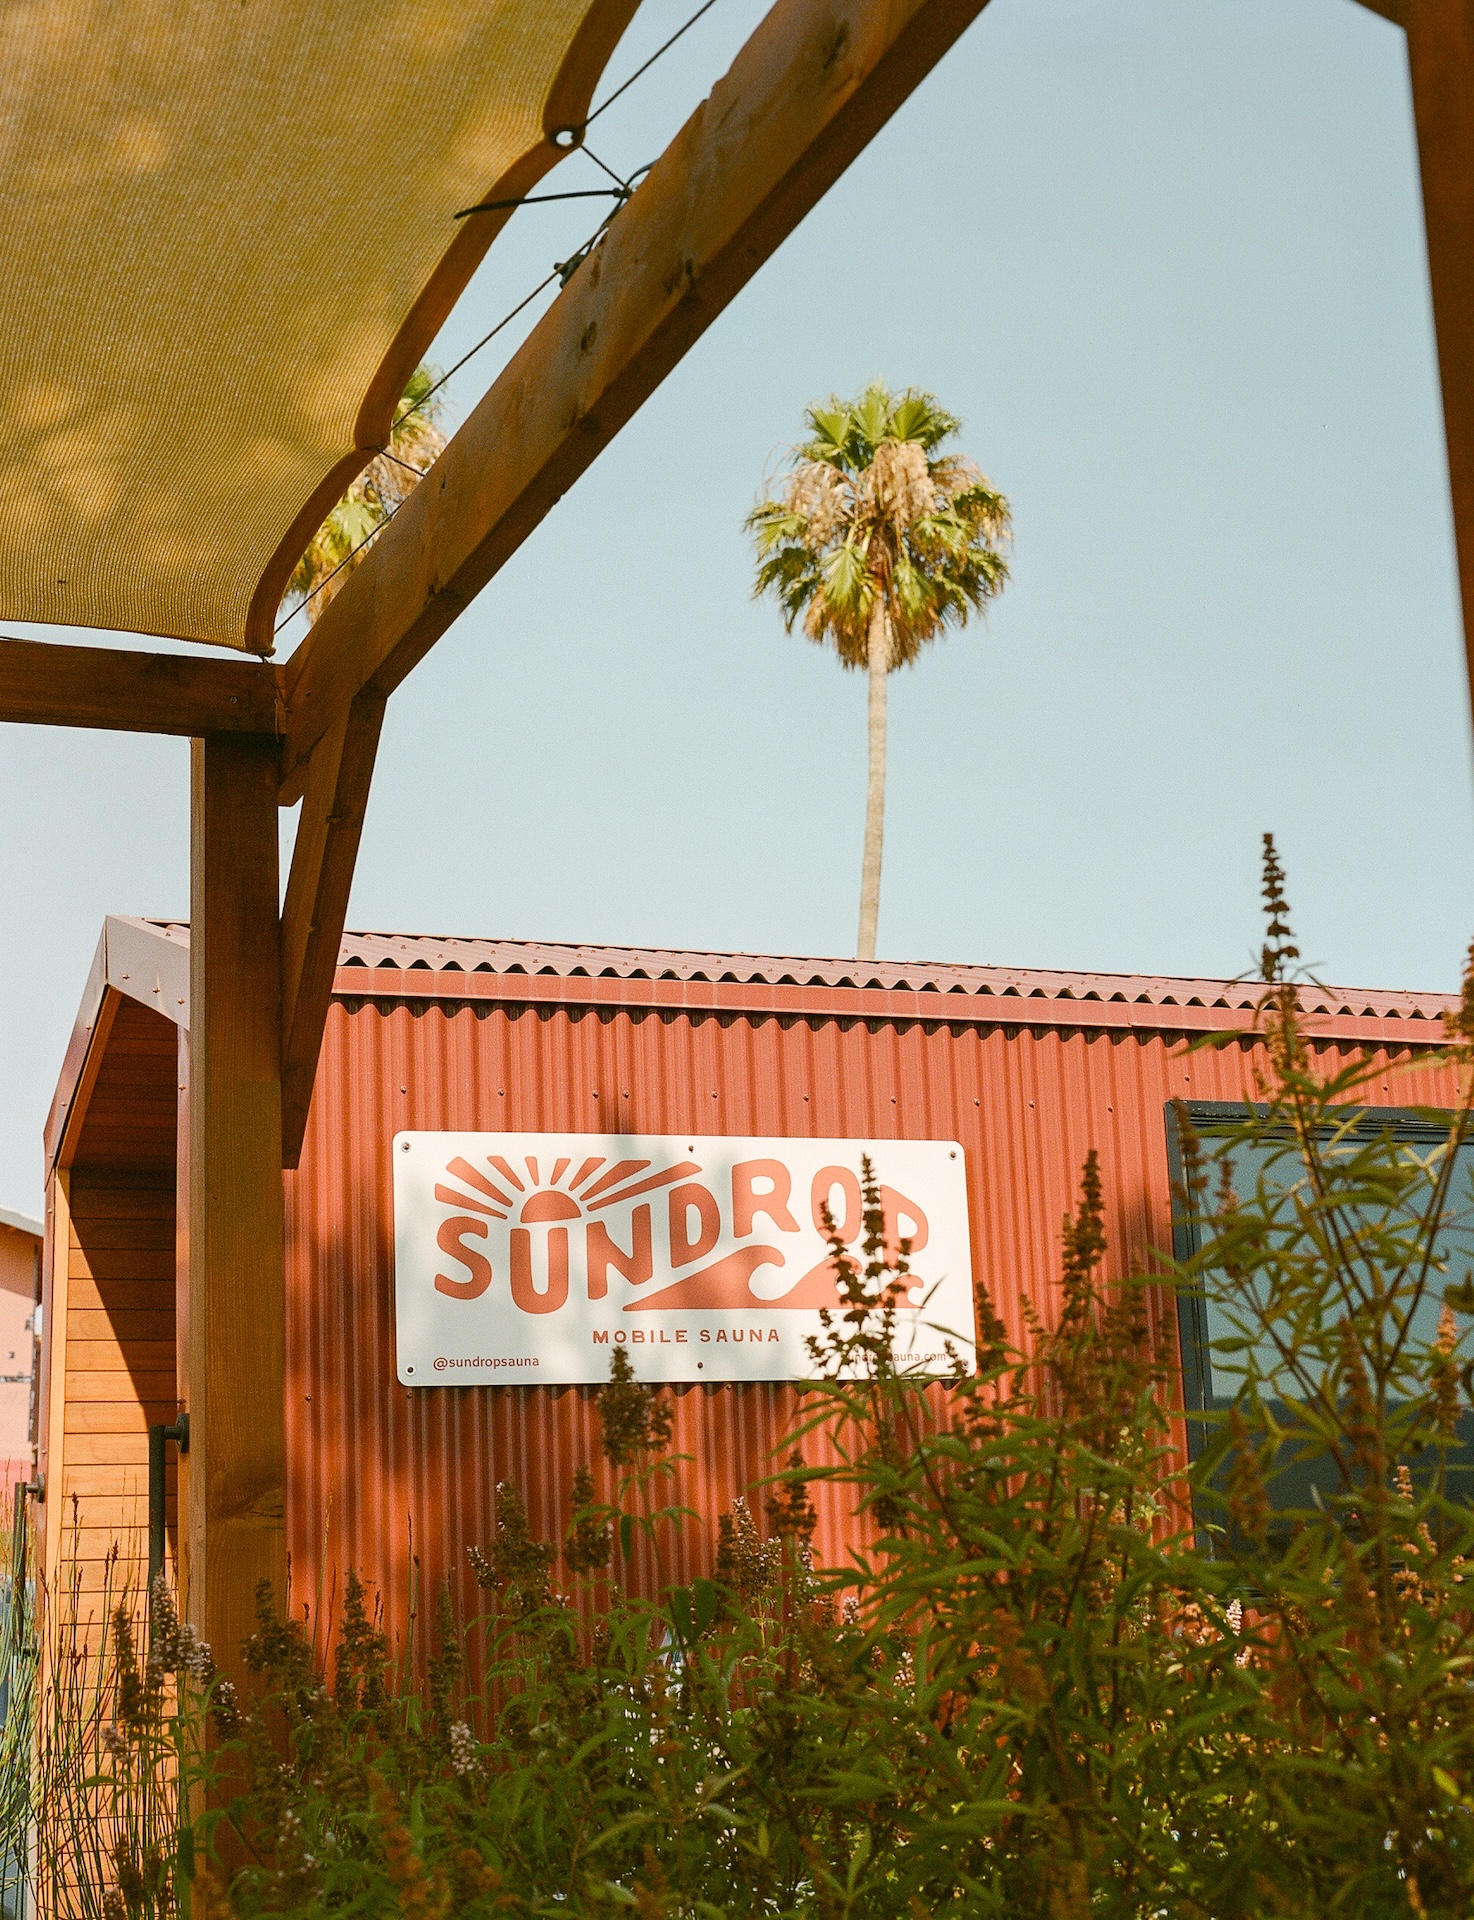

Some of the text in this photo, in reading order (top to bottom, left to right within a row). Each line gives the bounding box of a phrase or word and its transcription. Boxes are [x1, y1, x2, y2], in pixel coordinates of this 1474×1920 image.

[434, 1158, 929, 1315] SUNDROP
[592, 1328, 780, 1344] MOBILE SAUNA
[433, 1356, 540, 1371] @sundropsauna
